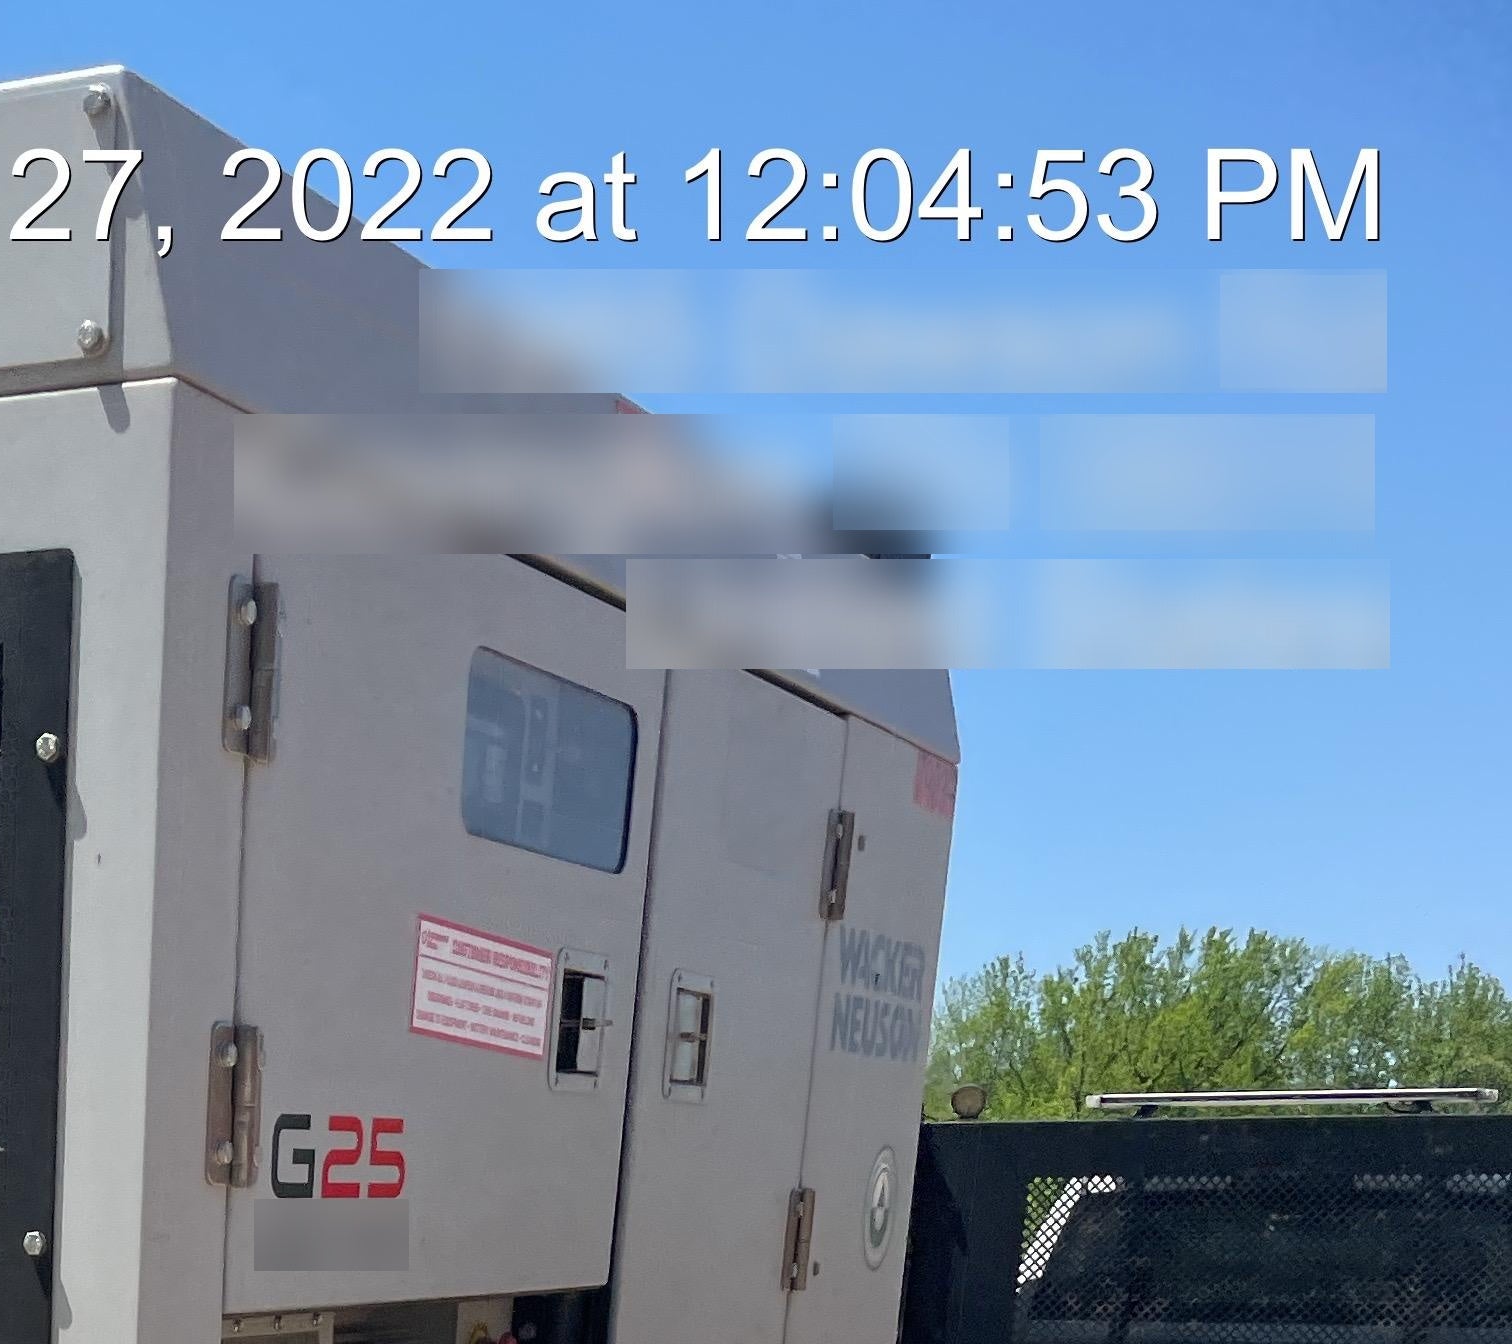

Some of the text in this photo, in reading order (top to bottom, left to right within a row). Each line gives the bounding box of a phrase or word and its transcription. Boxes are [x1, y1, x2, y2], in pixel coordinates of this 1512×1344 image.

[839, 923, 926, 1001] WACKER
[830, 992, 923, 1063] NEUSON
[271, 1113, 406, 1199] G25
